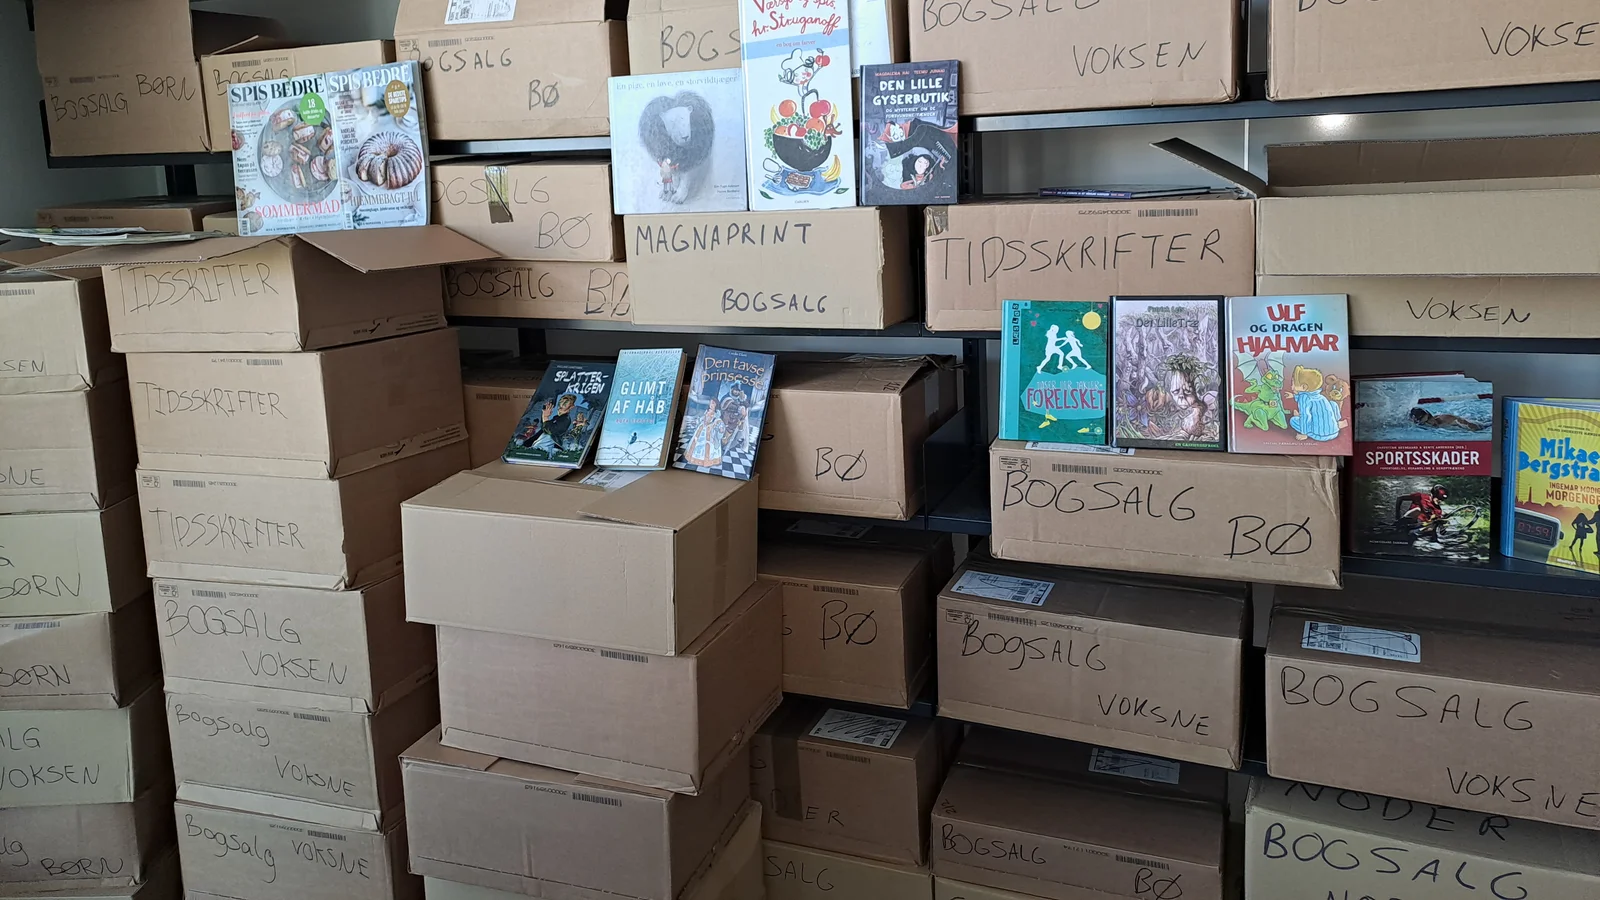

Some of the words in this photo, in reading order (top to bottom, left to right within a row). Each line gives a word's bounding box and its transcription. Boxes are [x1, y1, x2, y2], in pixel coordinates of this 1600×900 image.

[769, 11, 841, 36] Struganoff
[1072, 40, 1207, 77] VOKSEN
[136, 73, 196, 101] BØRN
[231, 84, 268, 103] SPIS
[270, 77, 325, 99] BEDRE
[329, 73, 361, 93] SPIS
[362, 65, 410, 88] BEDRE
[616, 82, 627, 90] En
[628, 80, 645, 91] pige,
[646, 80, 655, 88] en
[656, 78, 674, 88] løve,
[879, 79, 905, 91] DEN
[910, 77, 943, 90] LILLE
[49, 92, 129, 122] BOGSALG
[307, 98, 316, 108] 18
[528, 79, 560, 111] BØ
[872, 92, 949, 106] GYSERBUTIK
[255, 199, 340, 218] SOMMERMAD
[534, 211, 593, 249] BØ
[636, 220, 812, 256] MAGNAPRINT
[931, 228, 1224, 286] TIDSSKRIFTER
[448, 268, 554, 299] BOGSALG
[720, 288, 828, 313] BOGSALG
[1266, 303, 1306, 322] ULF
[1406, 297, 1530, 325] VOKSEN
[1250, 323, 1267, 333] OG
[1272, 322, 1323, 332] DRAGEN
[1236, 333, 1340, 357] HJALMAR
[554, 370, 609, 383] SPLATTER-
[701, 369, 764, 390] prinsesse
[704, 357, 730, 370] Den
[733, 358, 765, 376] tavse
[136, 381, 288, 420] TIDSSKRIFTER
[565, 382, 605, 394] KRIGEN
[620, 381, 666, 395] GLIMT
[1026, 388, 1105, 411] FORELSKET
[612, 400, 631, 414] AF
[635, 395, 666, 414] HÅB
[814, 446, 868, 482] BØ
[1365, 450, 1480, 466] SPORTSSKADER
[1002, 470, 1195, 521] BOGSALG
[1549, 481, 1579, 491] INGEMAR
[149, 508, 305, 554] TIDSSKRIFTER
[1224, 515, 1312, 559] BØ
[165, 599, 302, 646] BOGSALG
[820, 599, 878, 650] BØ
[241, 650, 347, 685] VOKSEN
[1280, 665, 1533, 731] BOGSALG
[1097, 693, 1209, 736] VOKSNE
[274, 754, 356, 798] VOKSNE
[1447, 767, 1600, 818] VOKSNE
[941, 823, 1047, 865] BOGSALG
[41, 857, 123, 877] BØRN
[291, 838, 370, 879] VOKSNE
[1263, 822, 1528, 900] BOGSALG
[1134, 867, 1183, 900] BØ
